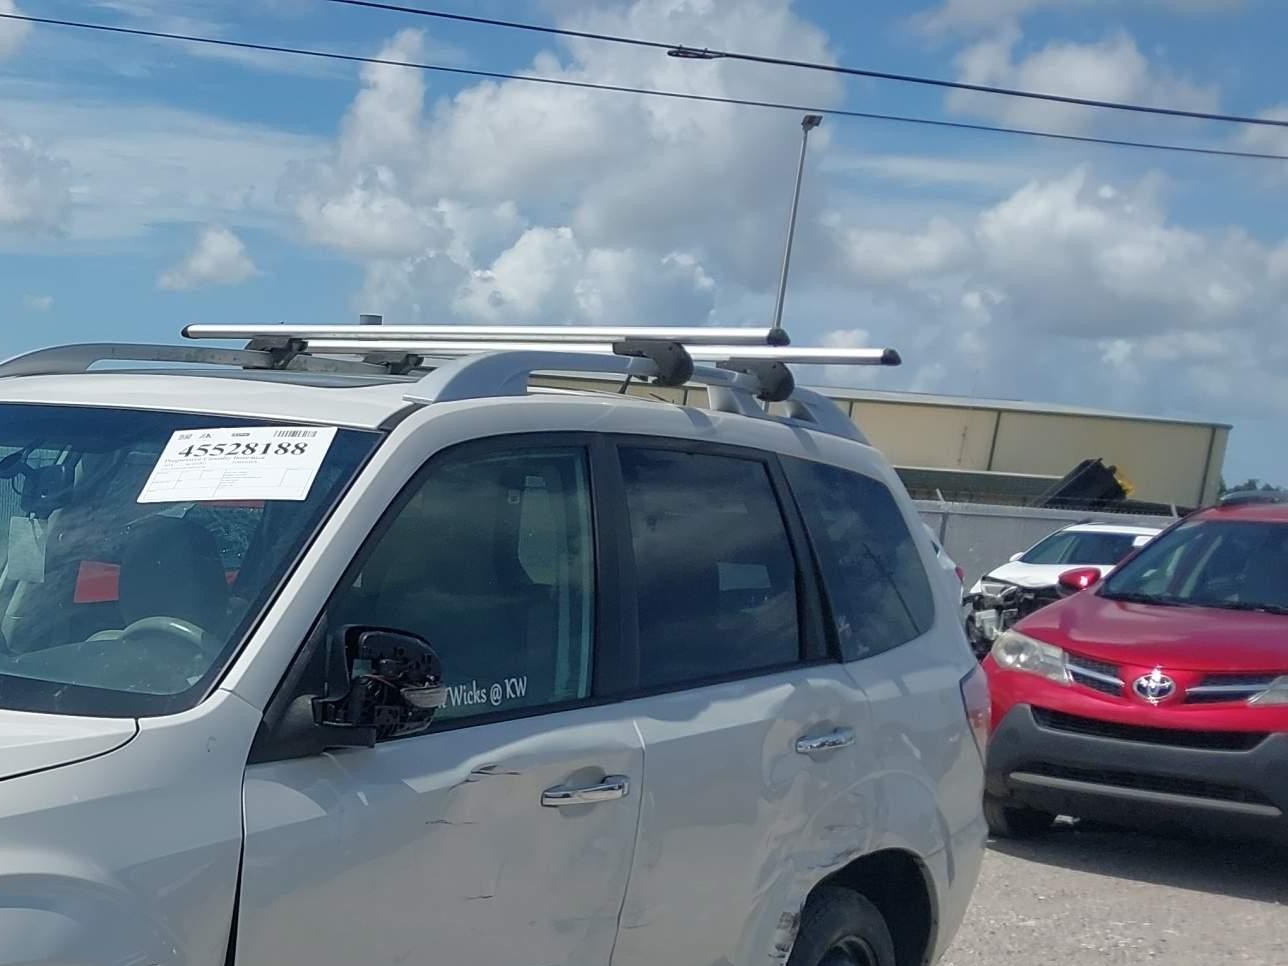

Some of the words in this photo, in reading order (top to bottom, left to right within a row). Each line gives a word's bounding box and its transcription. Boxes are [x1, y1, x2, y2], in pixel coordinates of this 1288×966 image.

[178, 441, 309, 457] 45528188
[446, 679, 487, 707] Wicks
[489, 683, 502, 706] @
[504, 675, 527, 699] KW
